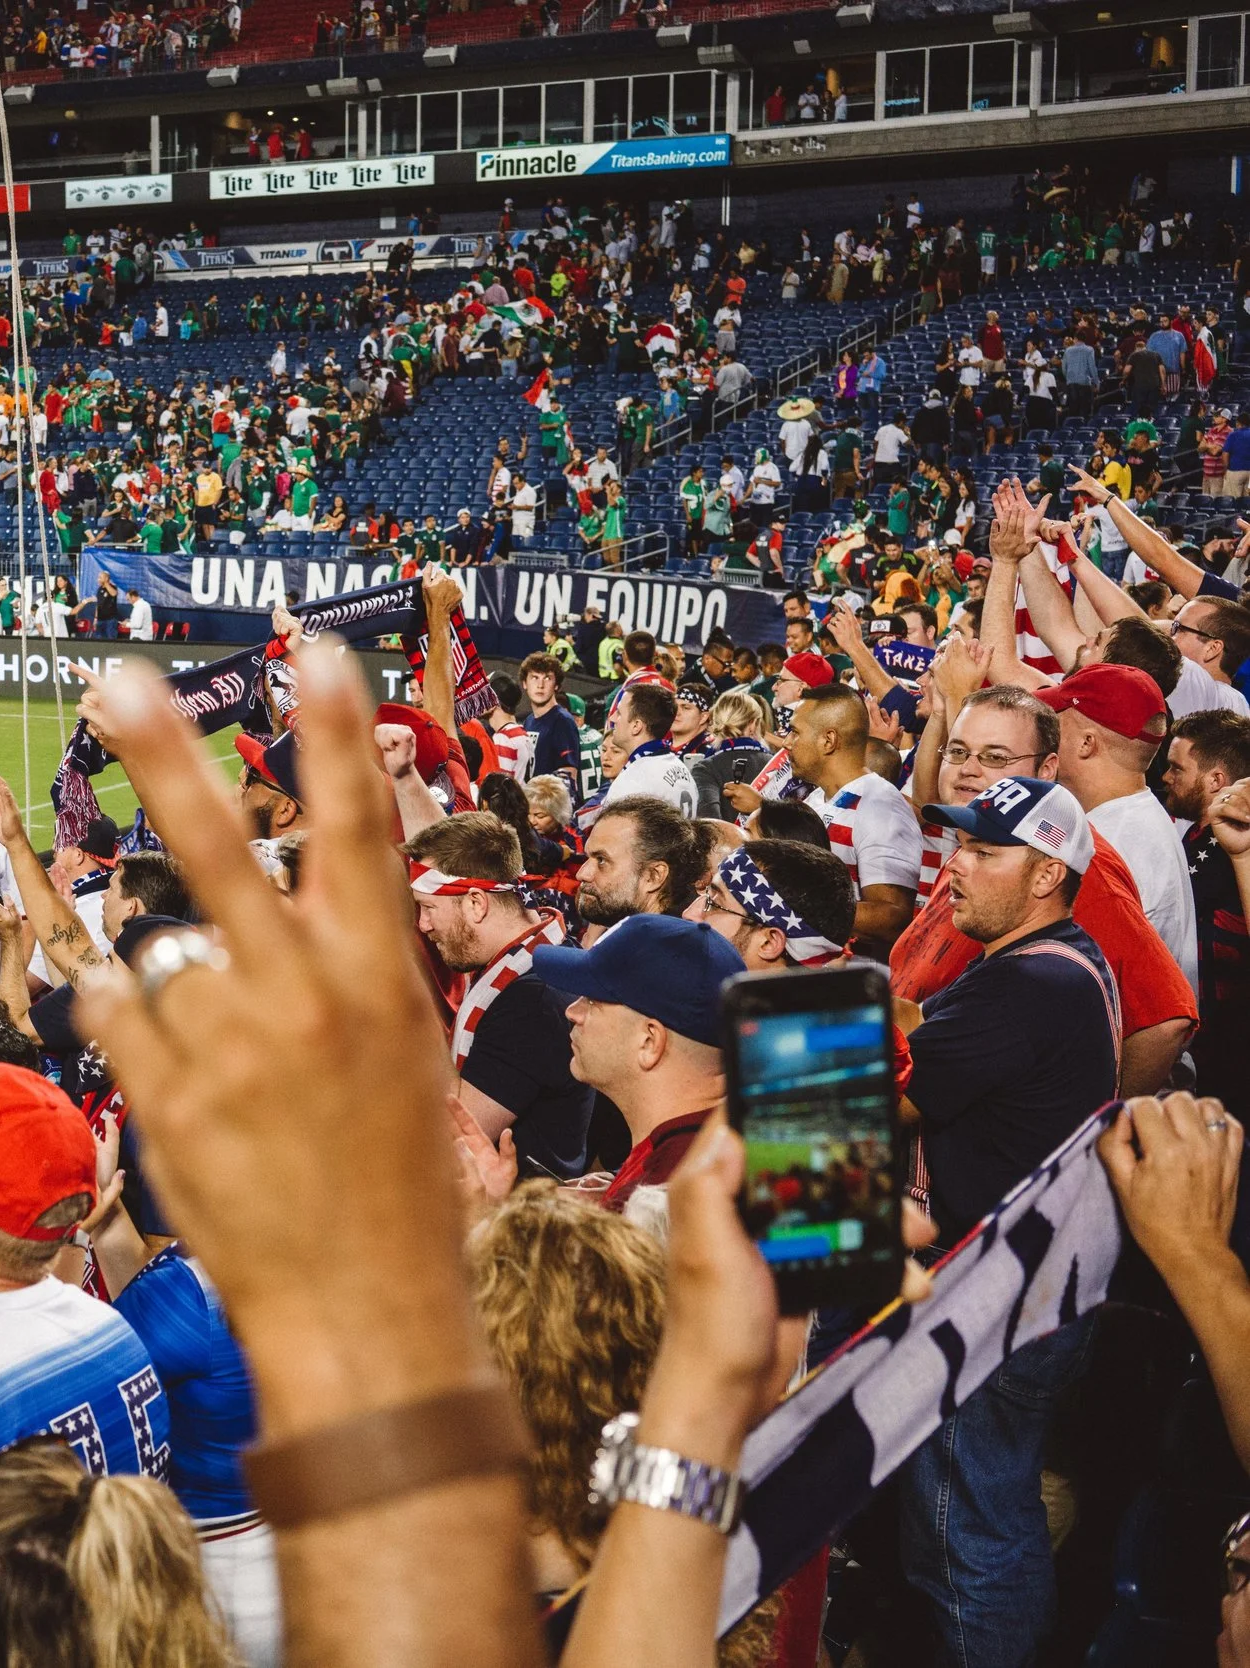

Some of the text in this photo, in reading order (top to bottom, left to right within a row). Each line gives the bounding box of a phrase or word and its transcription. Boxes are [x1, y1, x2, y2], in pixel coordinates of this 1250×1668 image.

[481, 150, 576, 178] Pinnacle
[610, 147, 726, 169] TitansBanking.com
[267, 174, 295, 194] Lite
[309, 170, 338, 190] Lite
[352, 167, 382, 187] Lite
[396, 164, 427, 185] Lite
[224, 175, 252, 196] Lite
[197, 249, 235, 266] TITANS
[260, 248, 307, 260] TITANUP
[32, 259, 70, 276] TITANS
[190, 556, 287, 609] UNA
[514, 571, 573, 628] UN
[882, 648, 927, 673] TAKE
[975, 777, 1032, 815] SA
